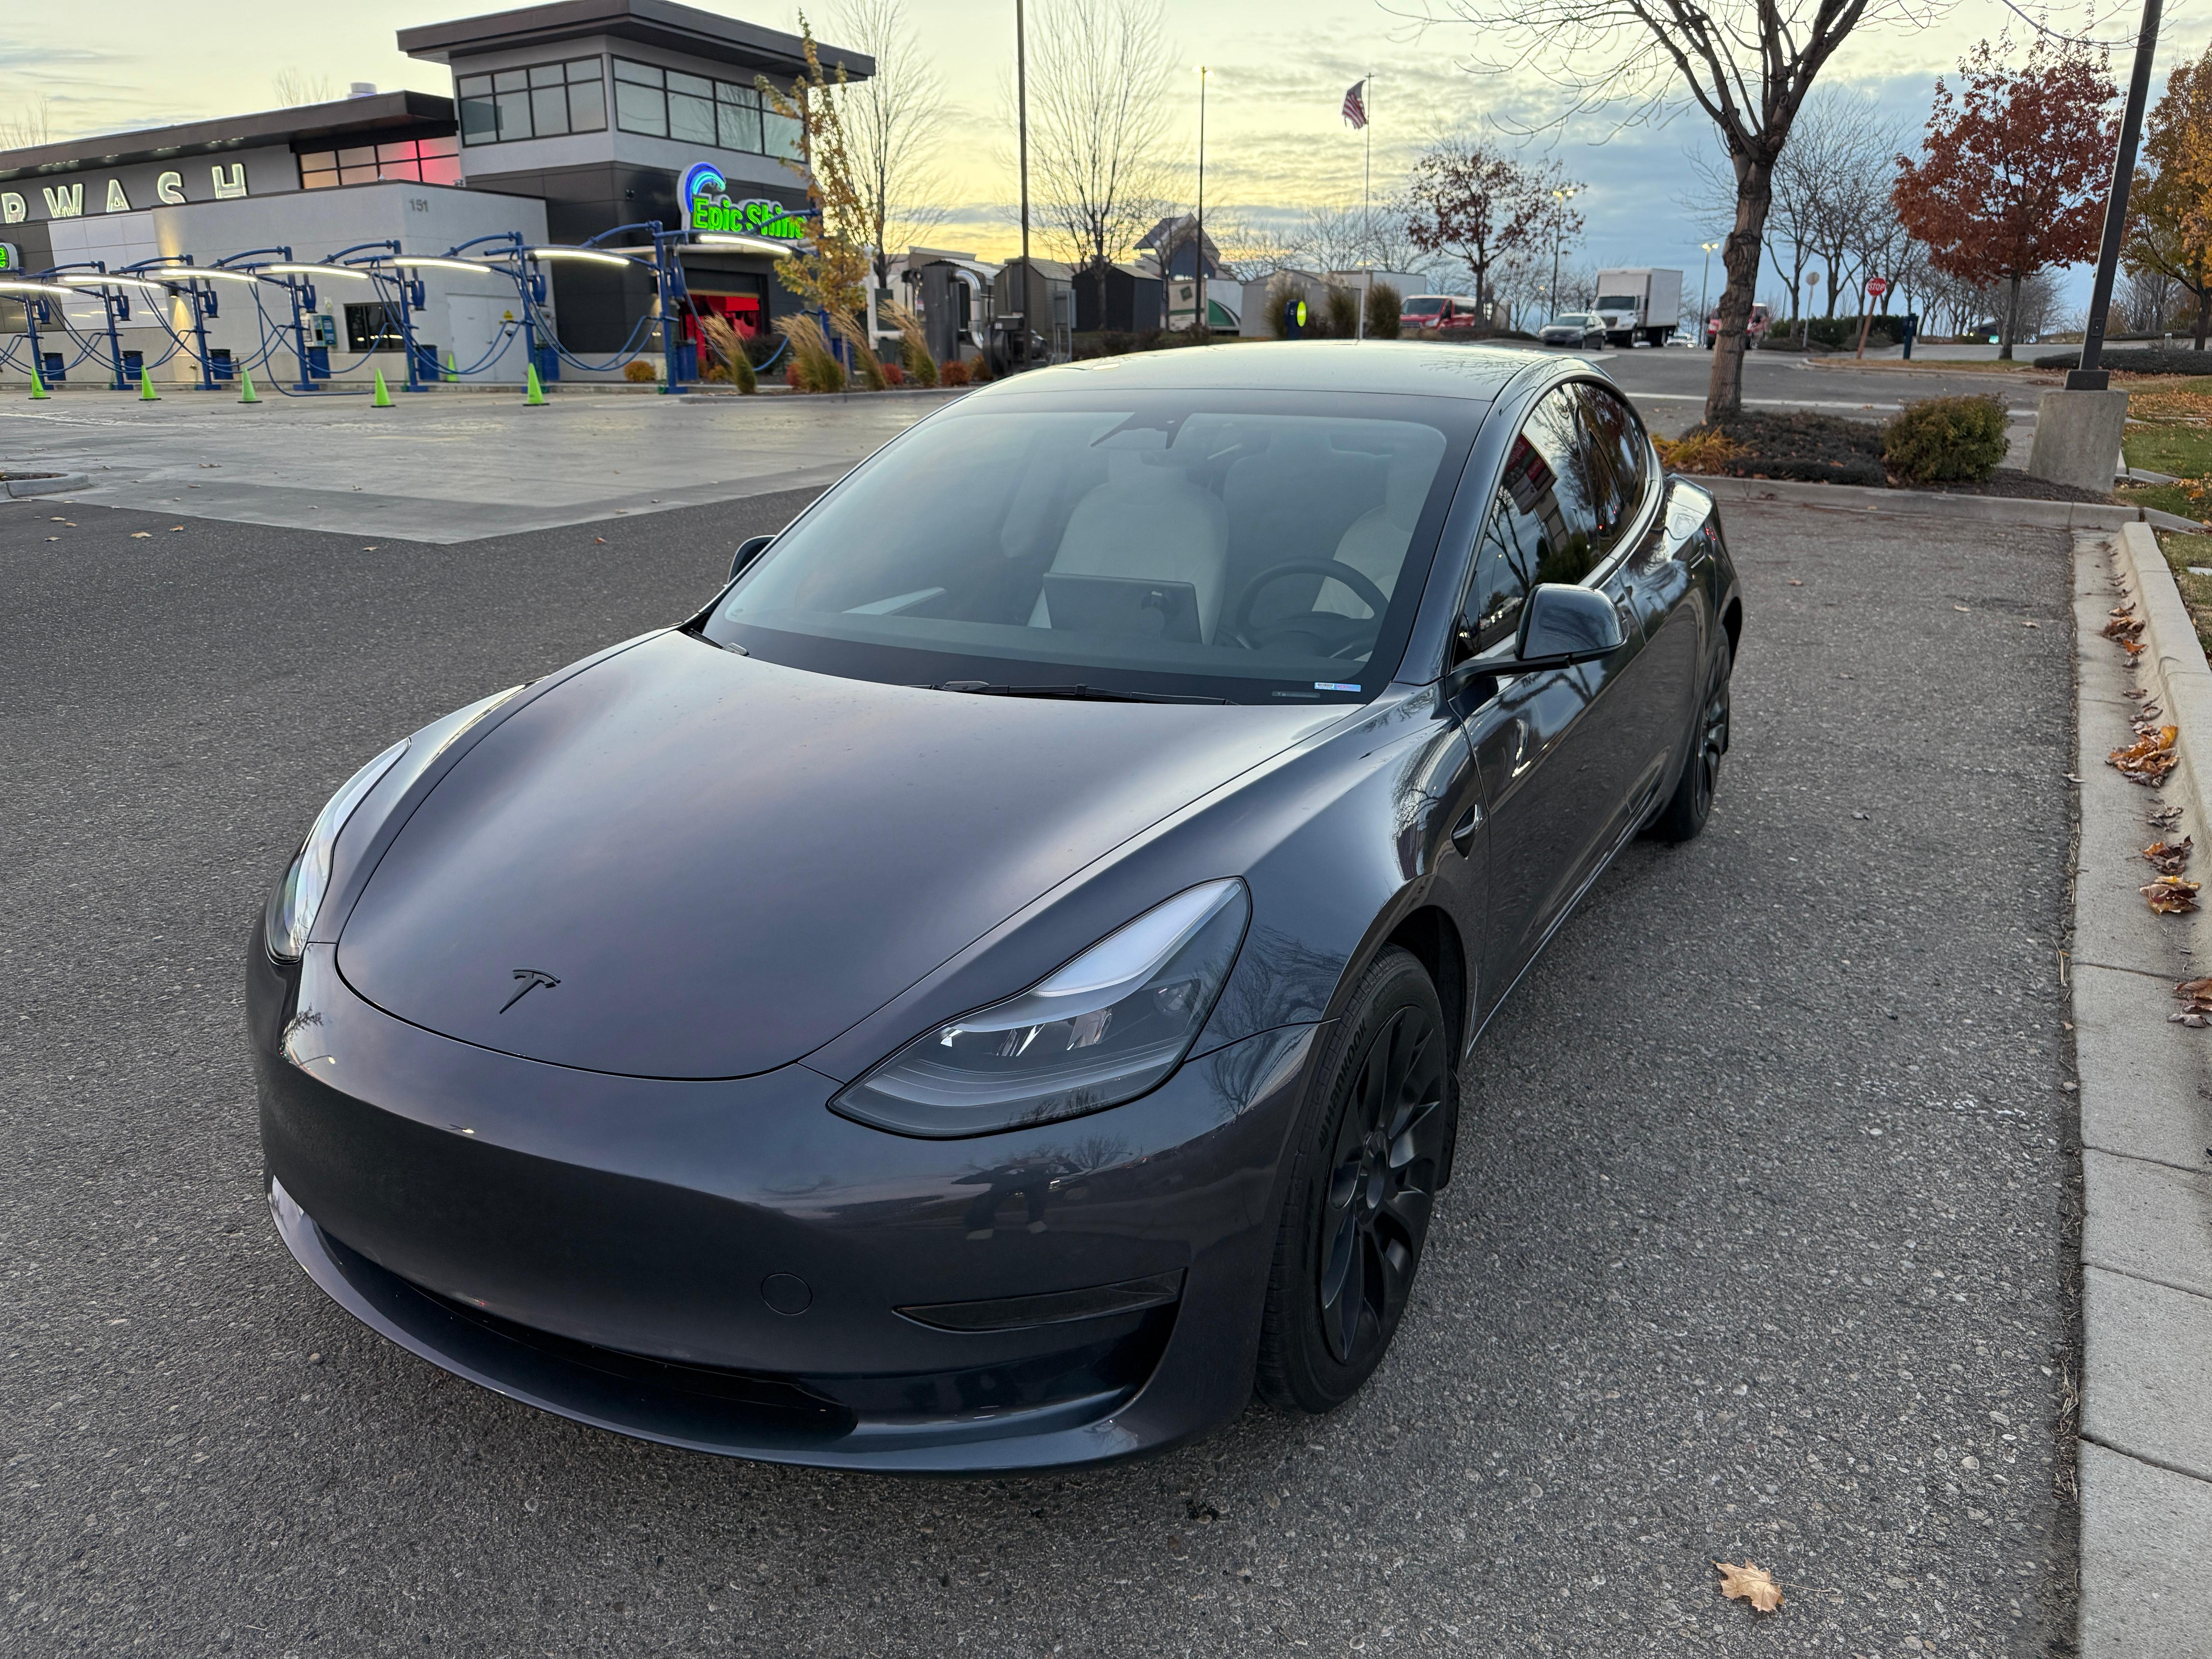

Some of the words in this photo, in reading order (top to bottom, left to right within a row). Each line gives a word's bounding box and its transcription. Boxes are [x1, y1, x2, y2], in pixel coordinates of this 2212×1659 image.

[409, 198, 428, 212] 151
[693, 198, 743, 232] Epic
[1868, 282, 1885, 291] STOP
